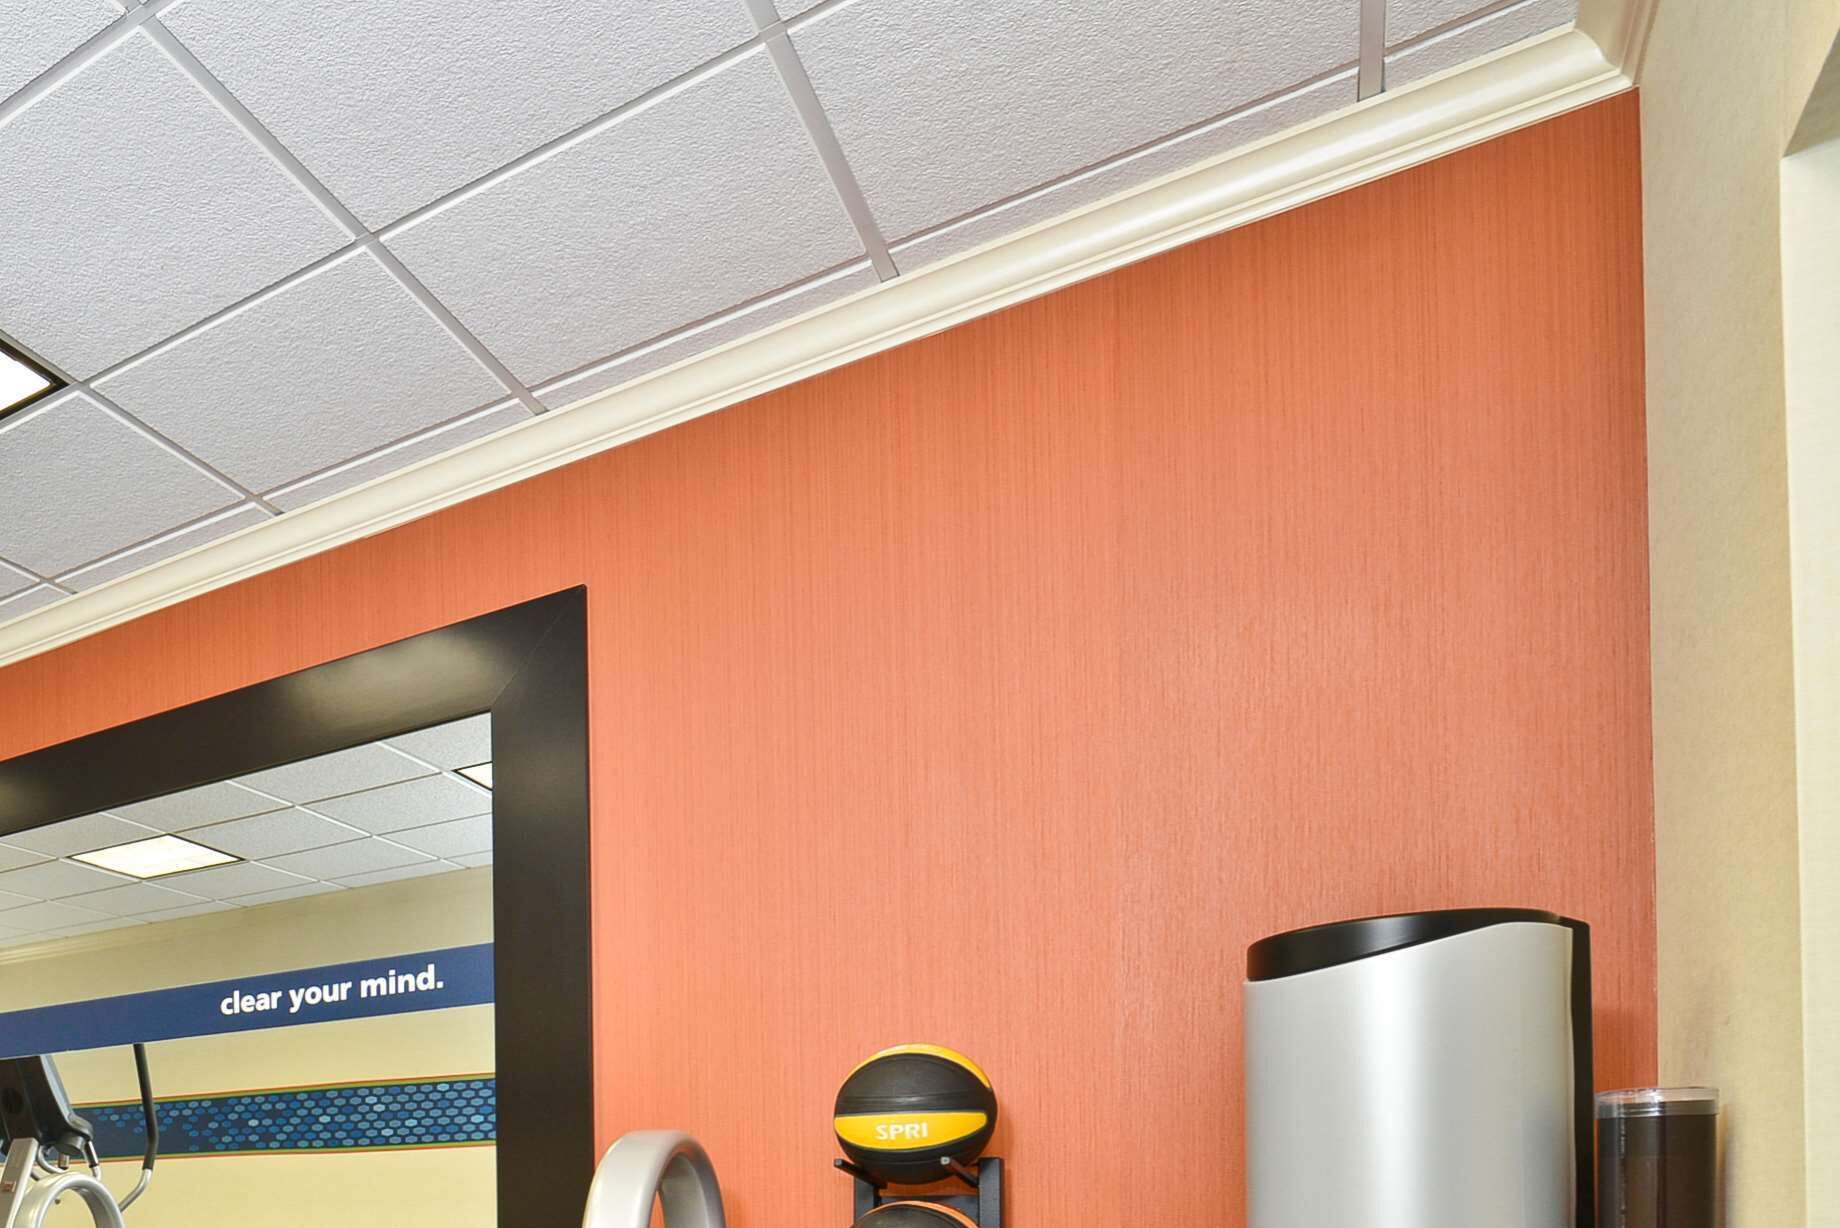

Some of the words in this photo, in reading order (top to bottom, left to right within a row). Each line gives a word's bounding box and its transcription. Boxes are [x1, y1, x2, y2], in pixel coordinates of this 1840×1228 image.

[220, 990, 282, 1015] clear
[289, 981, 352, 1013] your
[360, 963, 444, 998] mind.
[875, 1122, 929, 1140] SPRI
